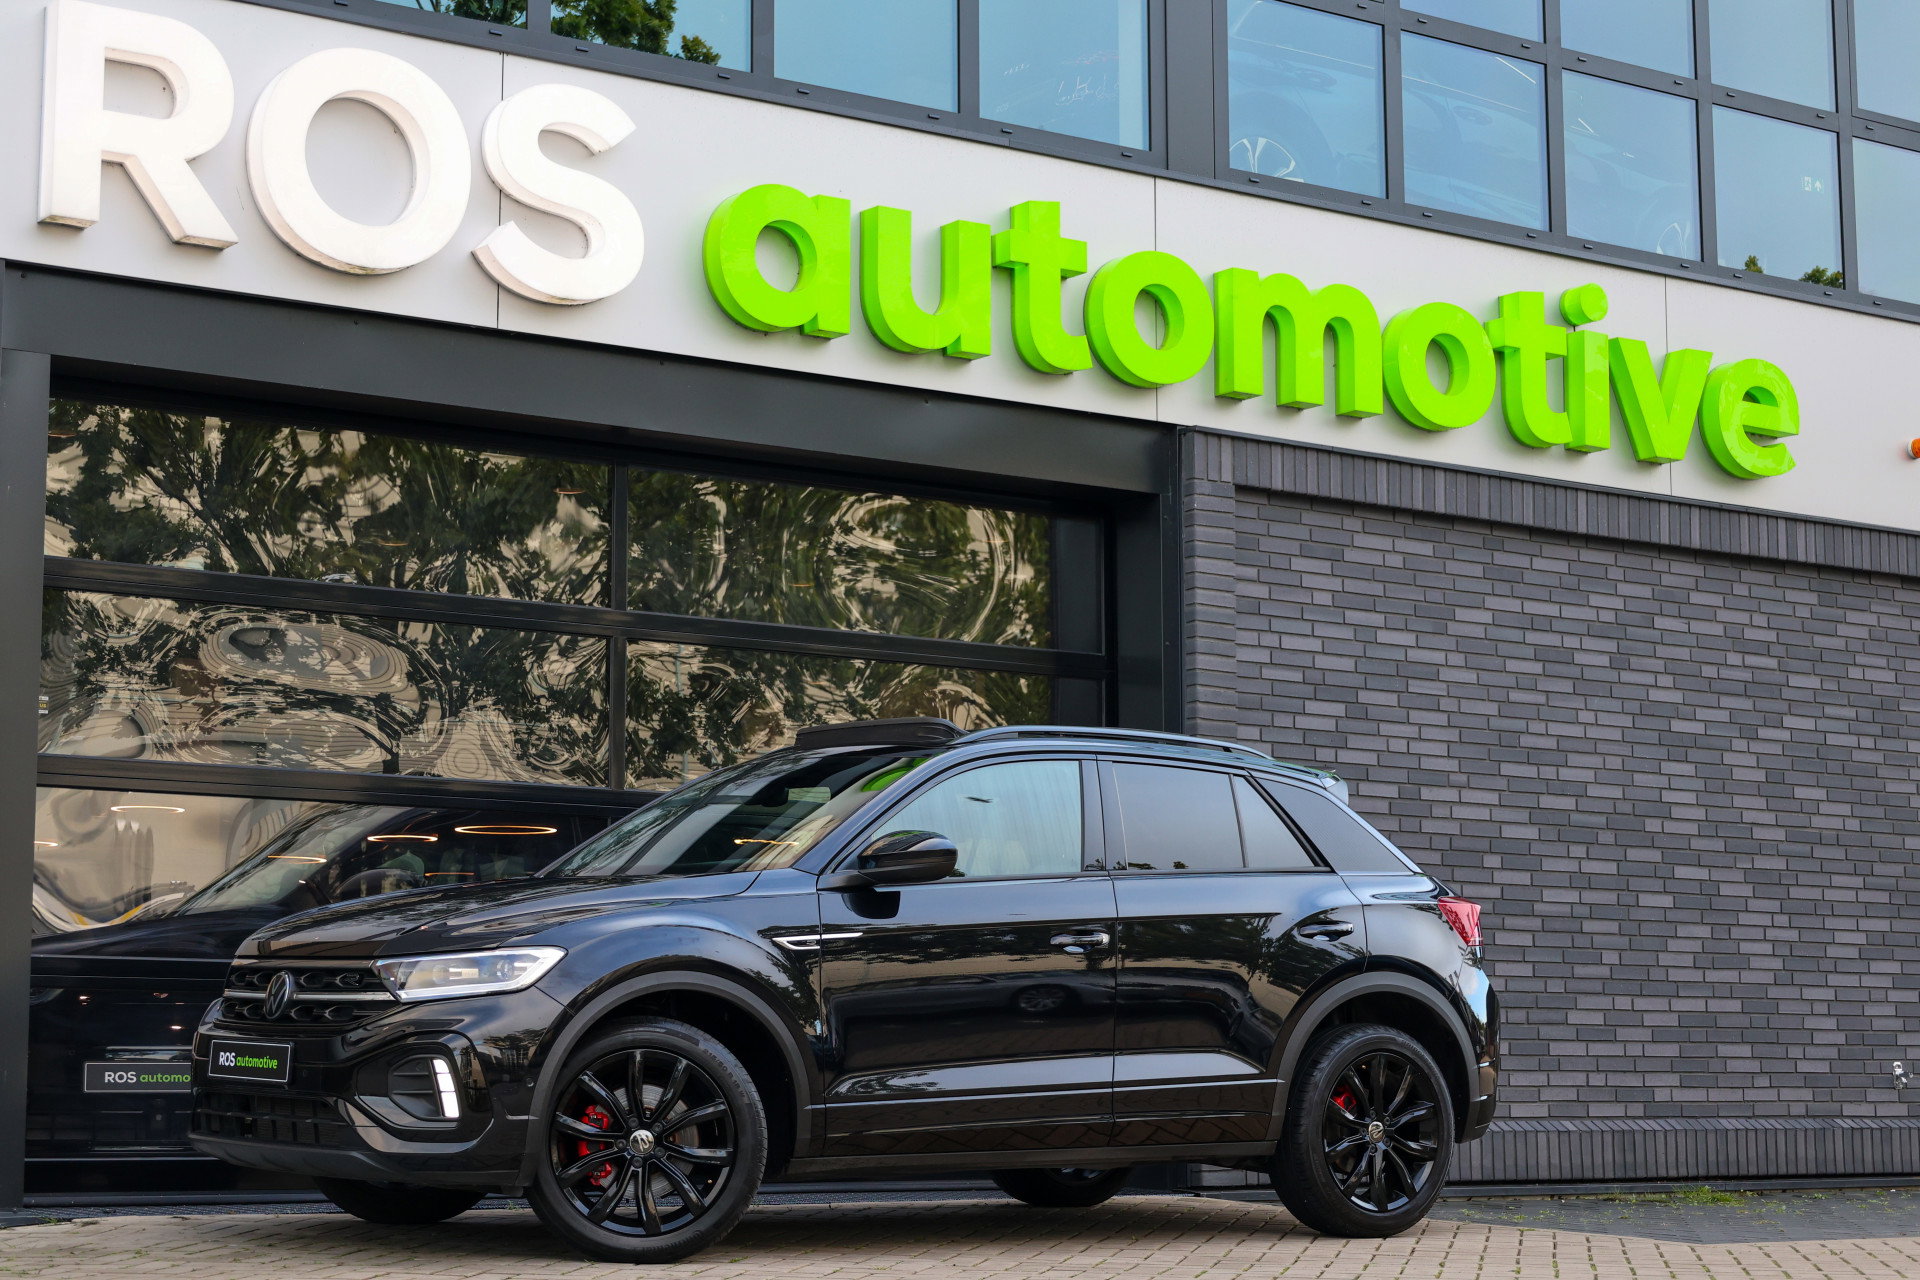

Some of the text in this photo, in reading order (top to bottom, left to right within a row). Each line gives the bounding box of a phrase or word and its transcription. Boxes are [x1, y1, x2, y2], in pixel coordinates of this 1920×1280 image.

[37, 0, 1801, 480] ROS automotive
[218, 1051, 278, 1069] ROS automotive
[104, 1071, 192, 1084] ROS automo
